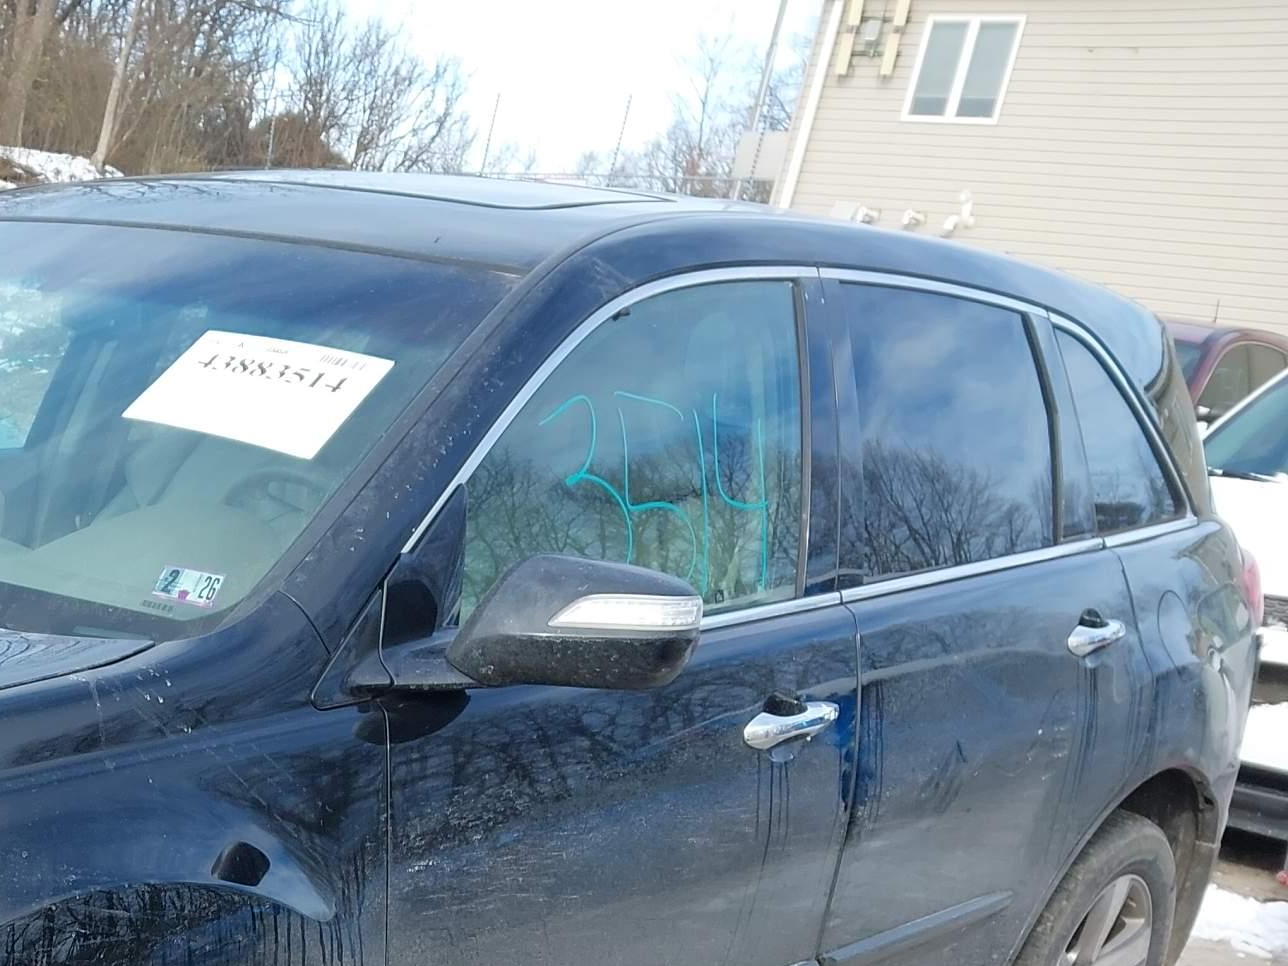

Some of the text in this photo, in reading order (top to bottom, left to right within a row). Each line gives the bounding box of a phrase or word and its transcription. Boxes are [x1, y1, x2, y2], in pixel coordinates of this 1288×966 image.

[198, 354, 348, 392] 43883514
[160, 569, 221, 600] 2 26
